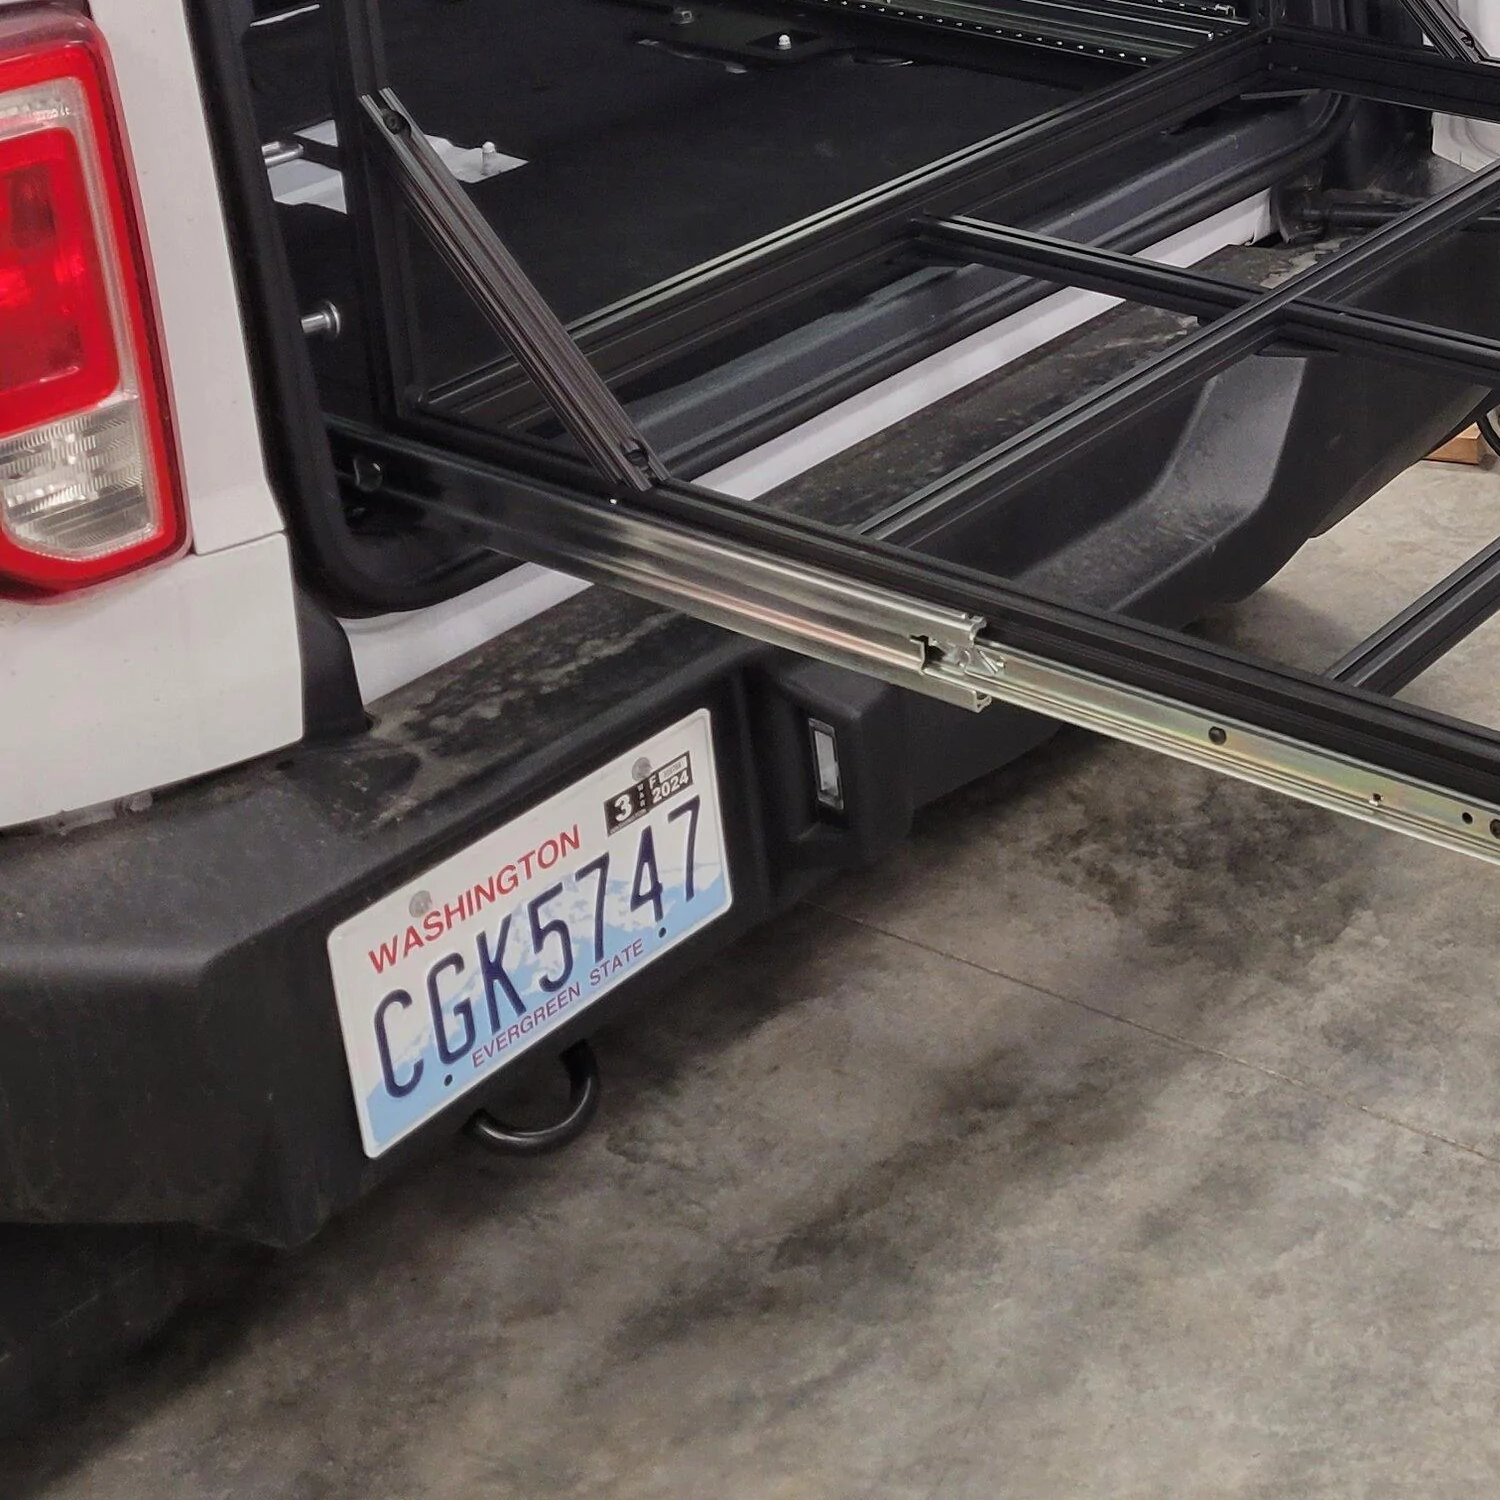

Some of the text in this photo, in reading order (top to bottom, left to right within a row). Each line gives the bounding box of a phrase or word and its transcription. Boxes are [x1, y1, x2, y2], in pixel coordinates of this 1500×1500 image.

[614, 794, 632, 822] 3
[651, 769, 689, 804] 2024
[368, 824, 581, 974] WASHINGTON
[373, 794, 701, 1098] CGK5747
[471, 938, 644, 1069] EVERGREEN STATE
